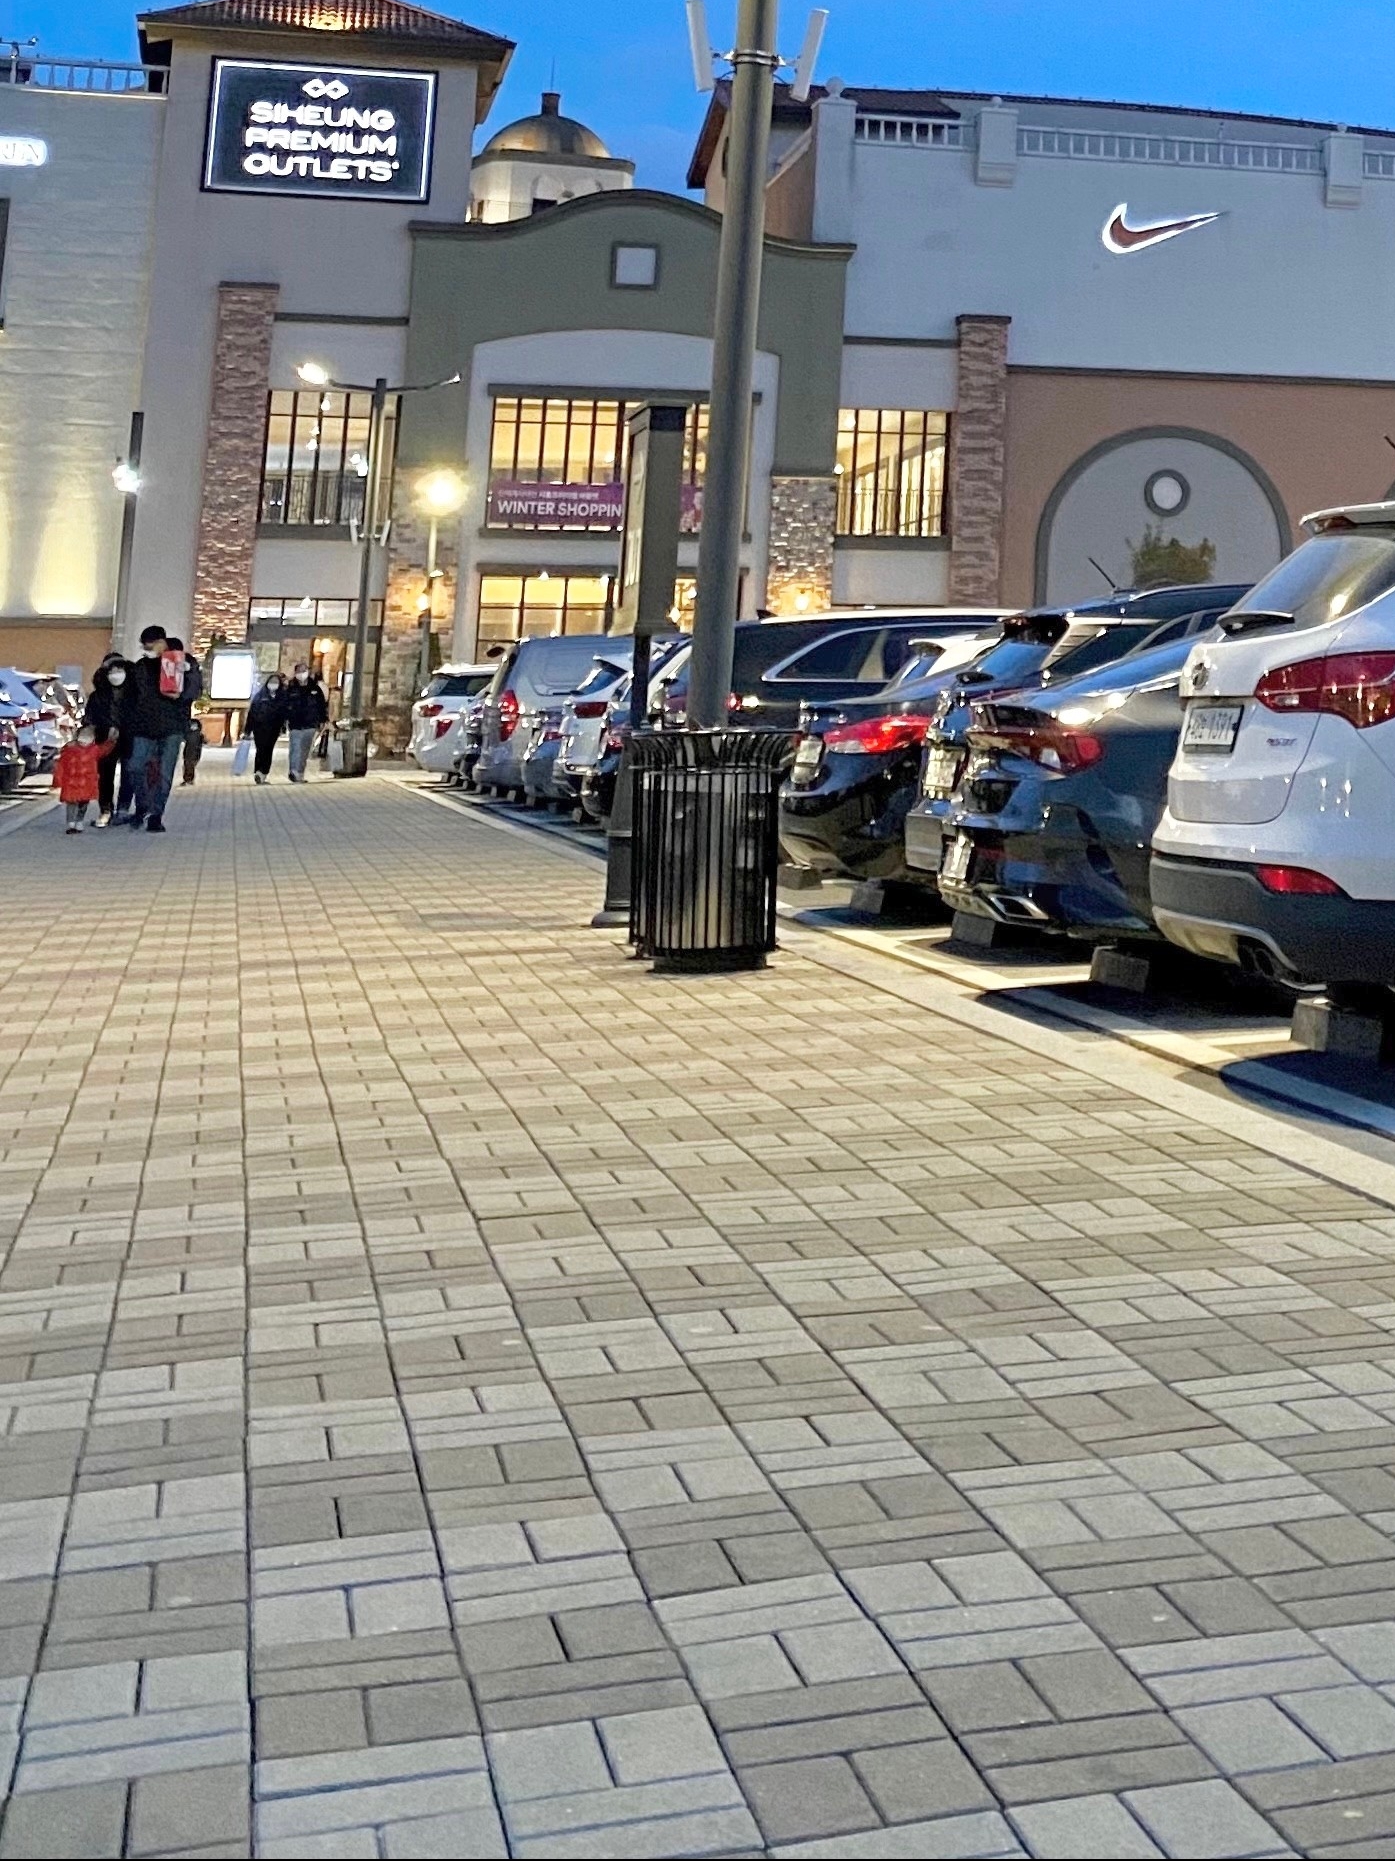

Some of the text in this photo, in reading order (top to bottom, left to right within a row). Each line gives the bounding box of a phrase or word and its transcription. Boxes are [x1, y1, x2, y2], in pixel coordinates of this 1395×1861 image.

[250, 101, 396, 132] SIHEUNG
[245, 126, 398, 157] PREMIUM
[497, 500, 556, 516] WINTER
